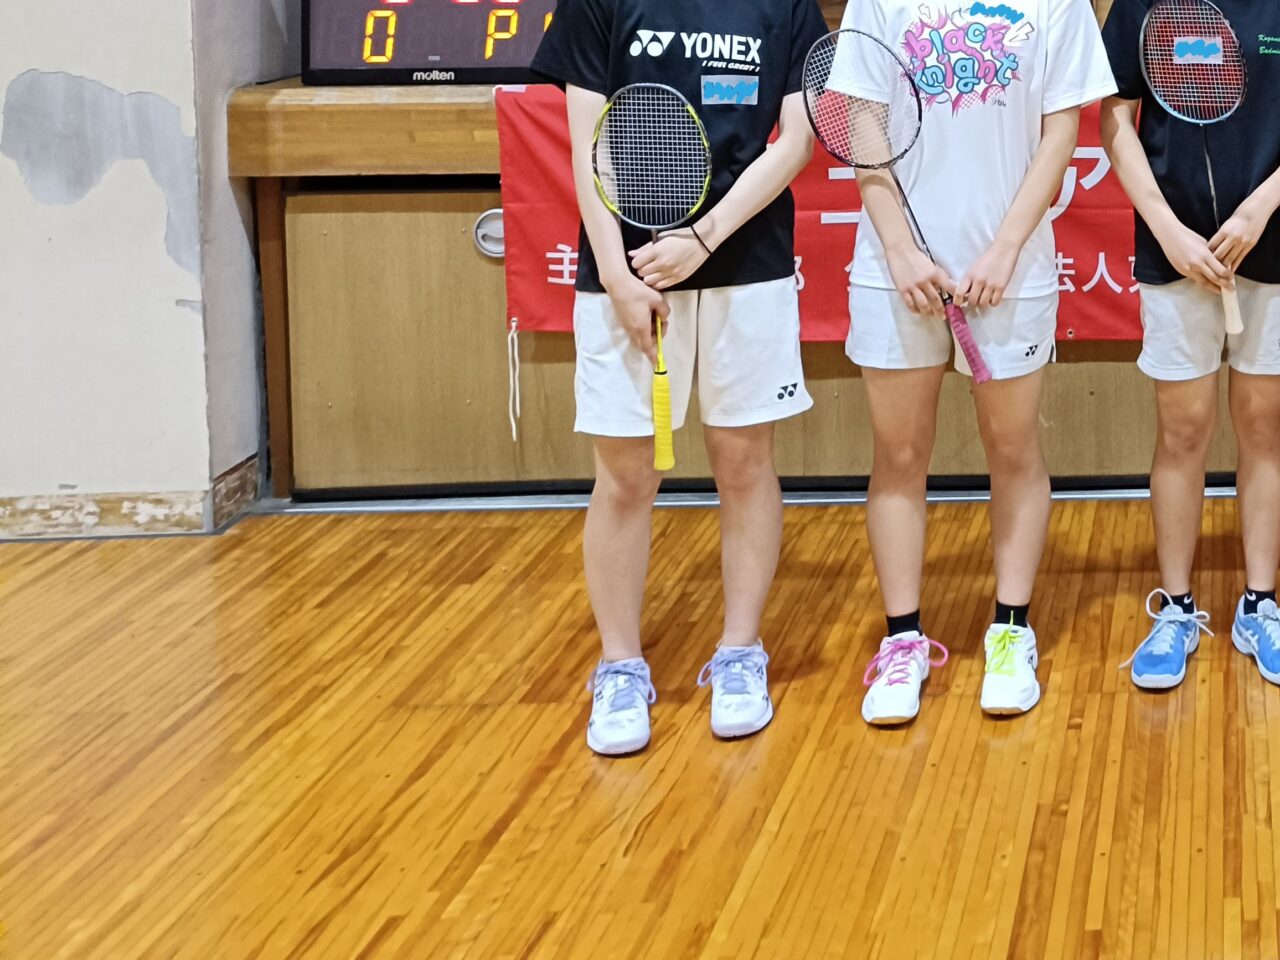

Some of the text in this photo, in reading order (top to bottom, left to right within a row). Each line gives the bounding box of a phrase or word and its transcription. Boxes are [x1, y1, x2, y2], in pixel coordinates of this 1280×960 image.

[362, 9, 397, 64] 0
[484, 8, 519, 60] P
[680, 31, 762, 64] YONEX
[412, 70, 455, 81] molten
